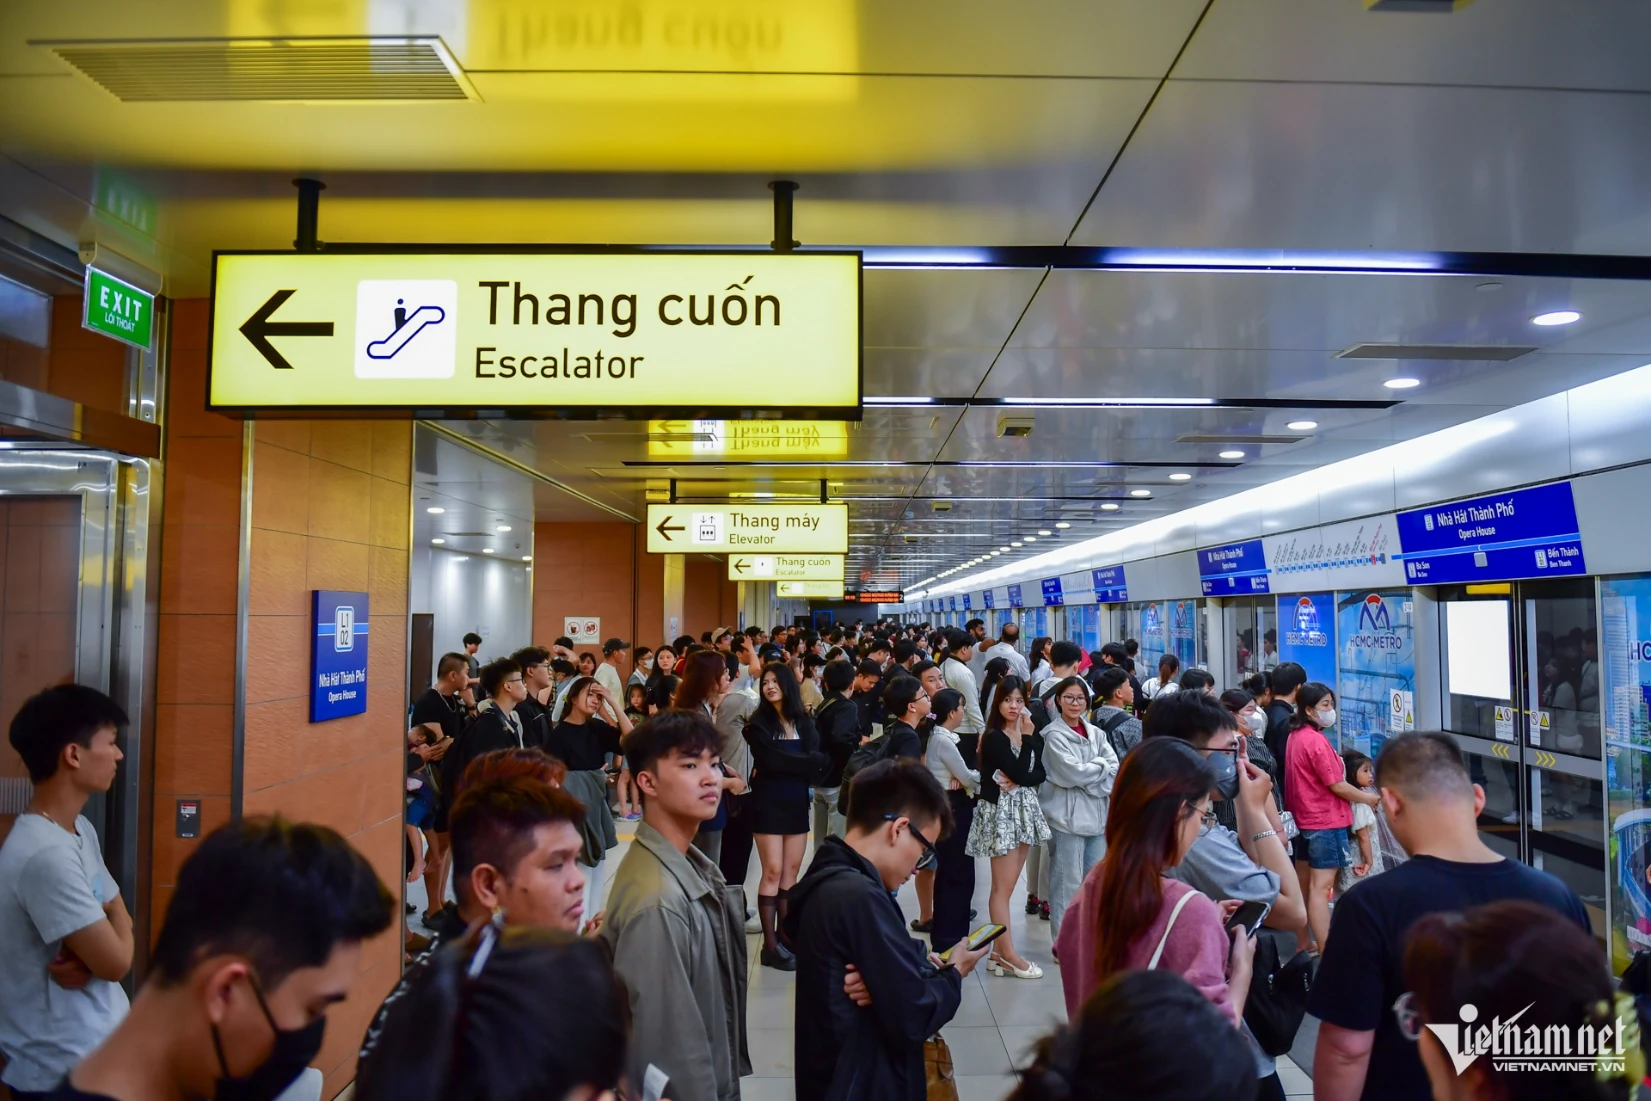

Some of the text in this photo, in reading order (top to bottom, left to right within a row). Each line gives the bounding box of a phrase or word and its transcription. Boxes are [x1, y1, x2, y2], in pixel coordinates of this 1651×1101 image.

[100, 285, 142, 322] EXIT
[478, 275, 781, 338] Thang cuốn
[475, 347, 645, 379] Escalator
[1437, 512, 1454, 527] Nhà
[1453, 509, 1468, 524] Hát
[1468, 505, 1495, 522] Thành
[1495, 498, 1515, 517] Phố
[730, 513, 820, 531] Thang máy
[729, 533, 775, 544] Elevator
[1458, 526, 1496, 540] Opera House
[776, 556, 805, 568] Thang
[341, 612, 349, 628] L1
[340, 630, 349, 645] 02
[319, 667, 366, 688] Nhà Hát Thành Phố
[328, 690, 357, 704] Opera House
